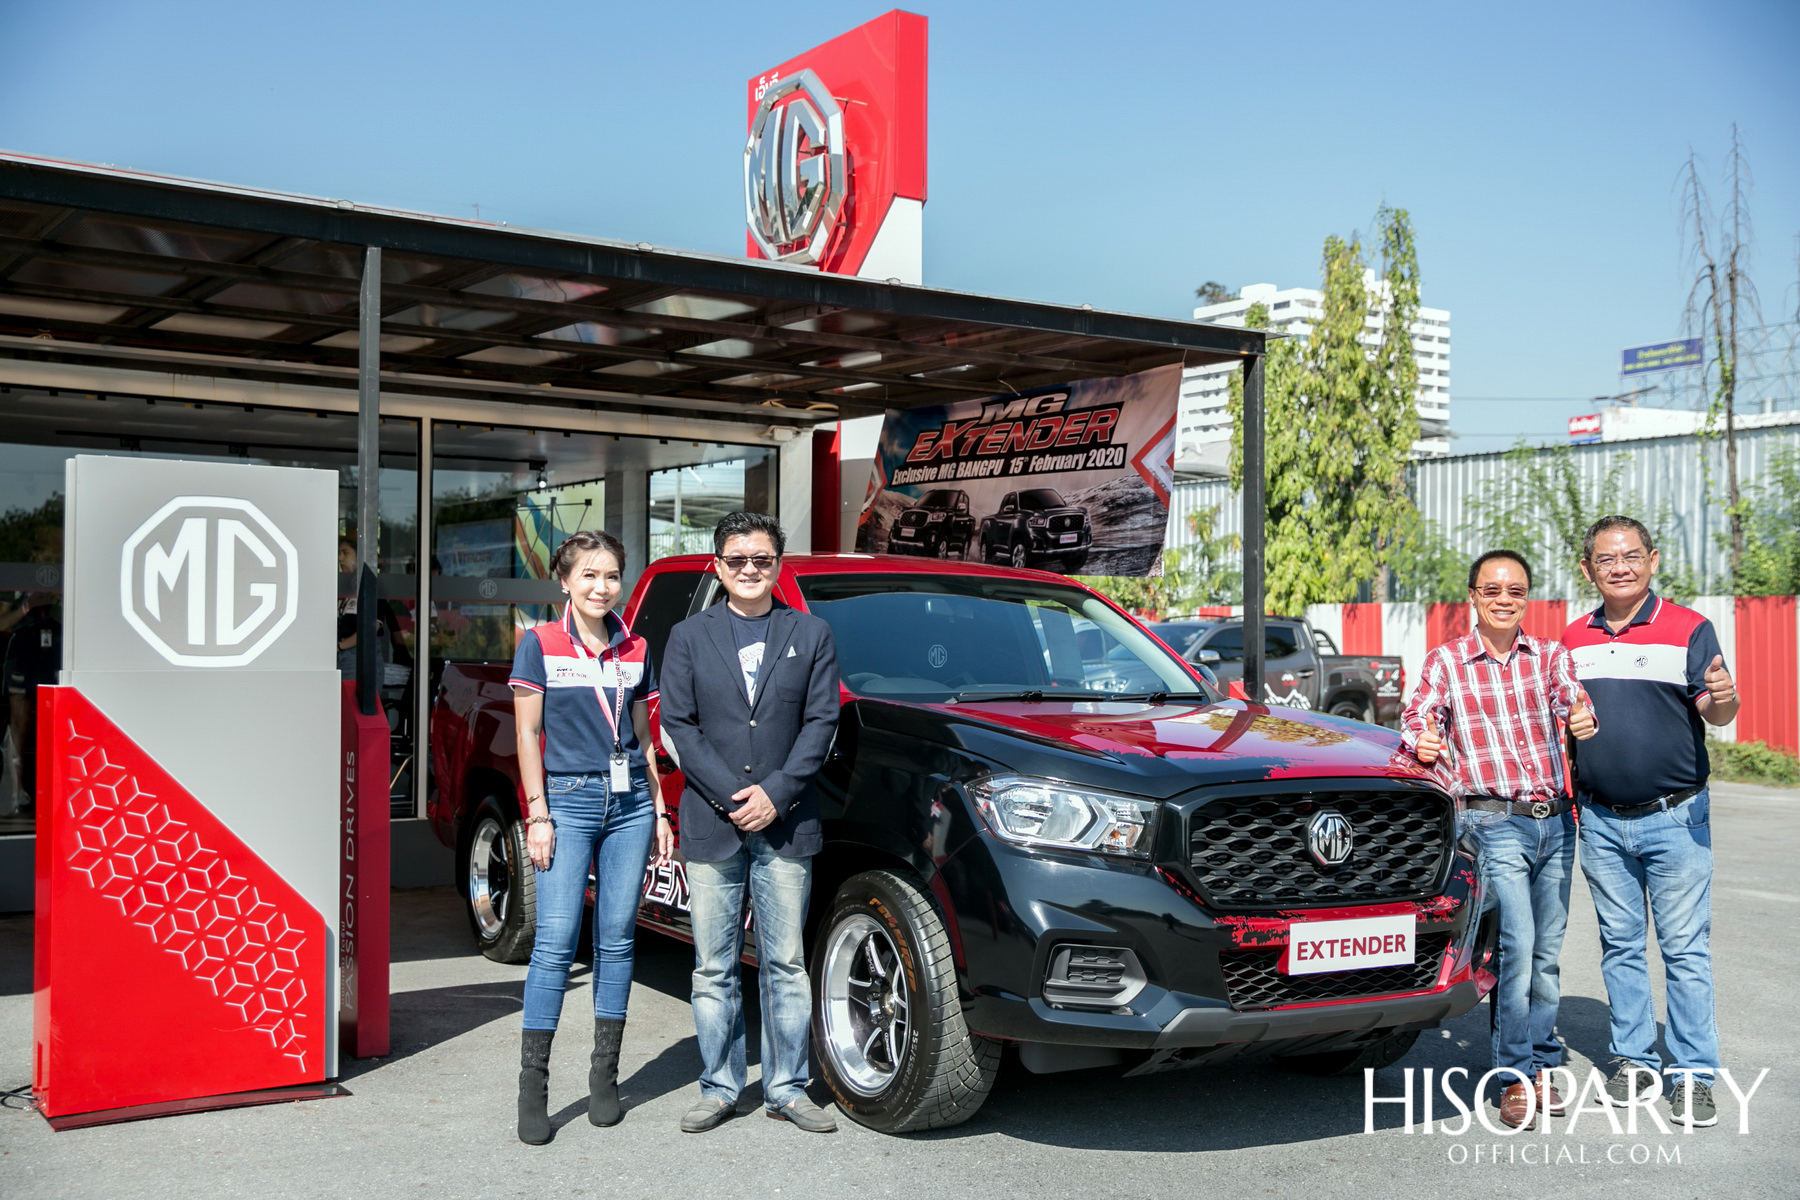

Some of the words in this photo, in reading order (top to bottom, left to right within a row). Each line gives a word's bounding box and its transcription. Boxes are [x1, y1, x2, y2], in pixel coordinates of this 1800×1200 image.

[748, 97, 828, 245] MG
[979, 392, 1068, 424] MG
[906, 407, 1120, 463] EXTENDER
[891, 465, 937, 486] Exclusive
[938, 463, 956, 480] MG
[956, 458, 1004, 478] BANGPU
[1029, 452, 1086, 473] February
[1088, 446, 1124, 468] 2020
[144, 517, 277, 646] MG
[930, 646, 945, 667] MG
[616, 678, 625, 716] MANAGING
[346, 751, 355, 862] DRIVES
[1317, 815, 1351, 861] MG
[345, 873, 355, 1010] PASSION
[1296, 934, 1407, 961] EXTENDER
